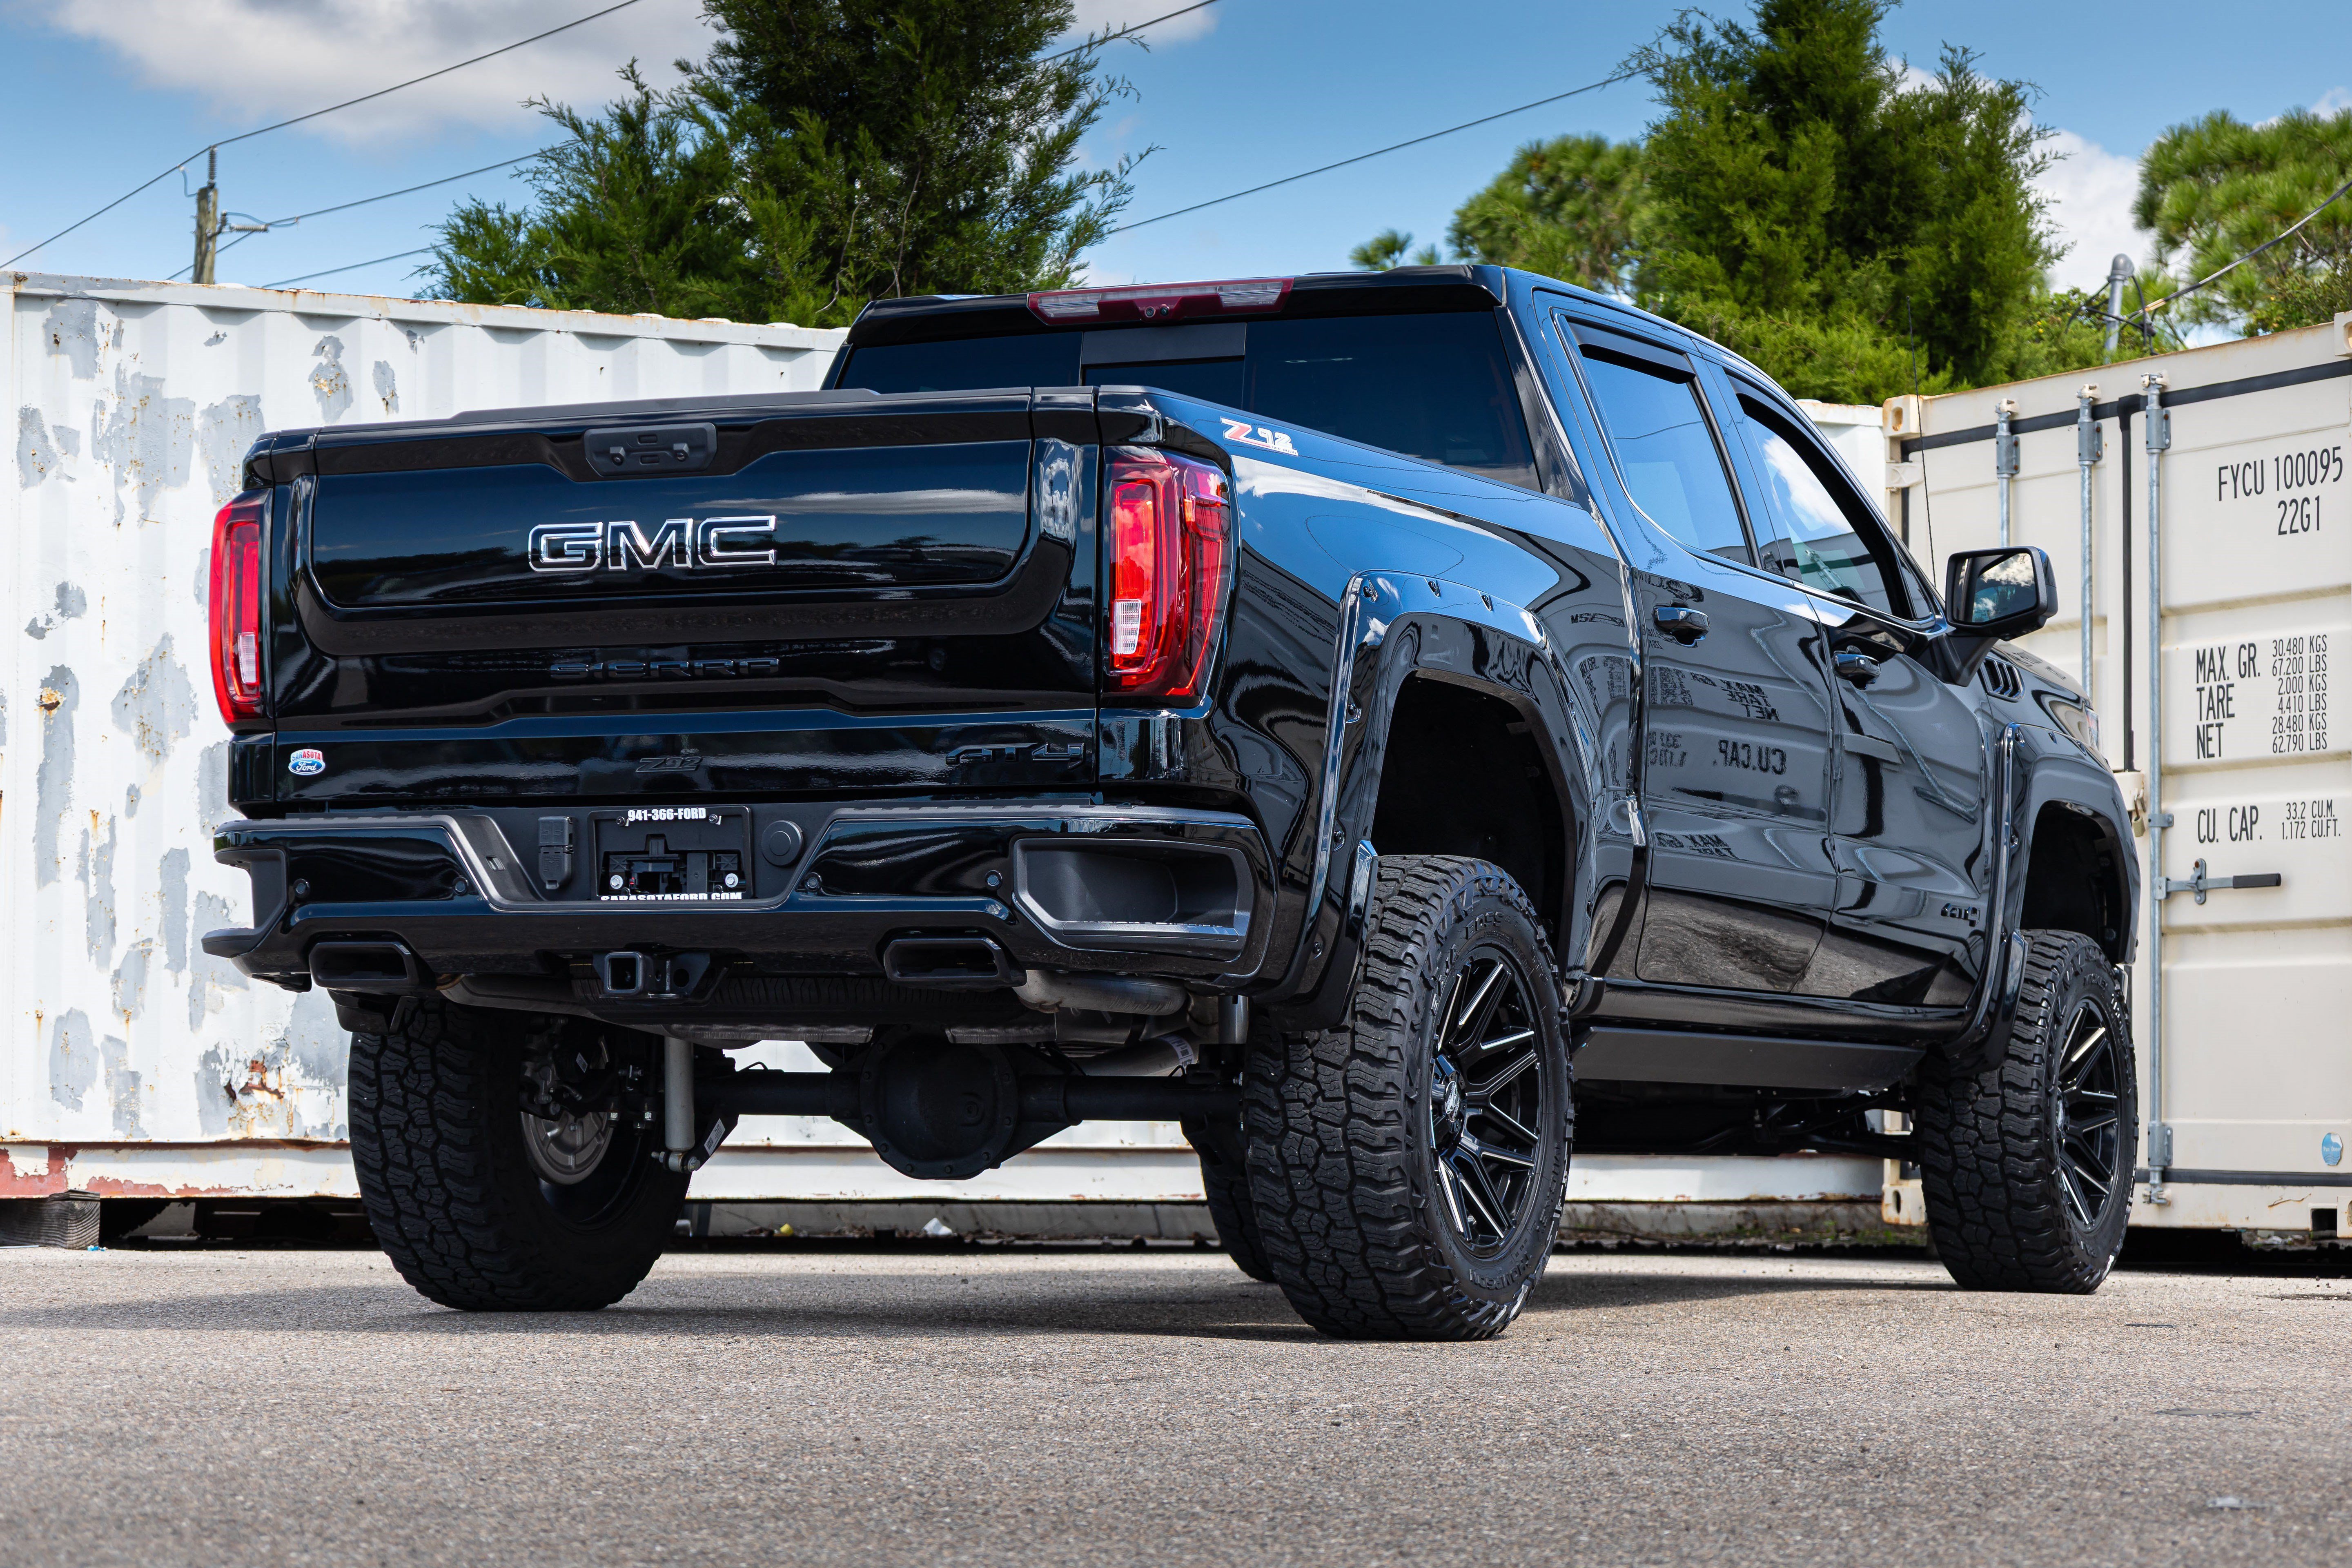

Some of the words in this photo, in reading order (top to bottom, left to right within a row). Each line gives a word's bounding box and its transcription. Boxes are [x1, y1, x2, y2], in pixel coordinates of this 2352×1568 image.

[1220, 417, 1298, 456] Z92
[2219, 460, 2264, 501] FYCU
[2275, 446, 2343, 491] 100095
[2278, 495, 2319, 535] 22G1
[528, 515, 777, 572] GMC
[2272, 637, 2303, 657] 30,480
[2309, 635, 2327, 653] KGS
[550, 658, 780, 679] SIERRA
[2196, 645, 2230, 684] MAX.
[2238, 642, 2261, 678] GR.
[2272, 656, 2303, 676] 67,200
[2309, 654, 2327, 673] LBS
[2278, 675, 2303, 695] 2,000
[2309, 673, 2327, 692] KGS
[2196, 683, 2235, 721] TARE
[2278, 695, 2303, 714] 4,410
[2309, 693, 2327, 711] LBS
[2272, 714, 2303, 734] 28,480
[2309, 712, 2327, 731] KGS
[2196, 722, 2224, 759] NET
[2272, 733, 2303, 753] 62,790
[2310, 731, 2327, 750] LBS
[292, 751, 321, 761] SARASOTA
[296, 760, 317, 771] Ford
[635, 756, 704, 772] Z92
[946, 742, 1085, 770] AT4
[628, 808, 706, 821] 941-366-FORD
[2286, 802, 2305, 820] 33.2
[2312, 800, 2334, 818] CU.M.
[2198, 809, 2218, 843] CU.
[2230, 806, 2262, 841] CAP.
[2282, 821, 2305, 840] 1,172
[2312, 818, 2341, 837] CU.FT.
[600, 892, 742, 901] SARASOTAFORDCOM
